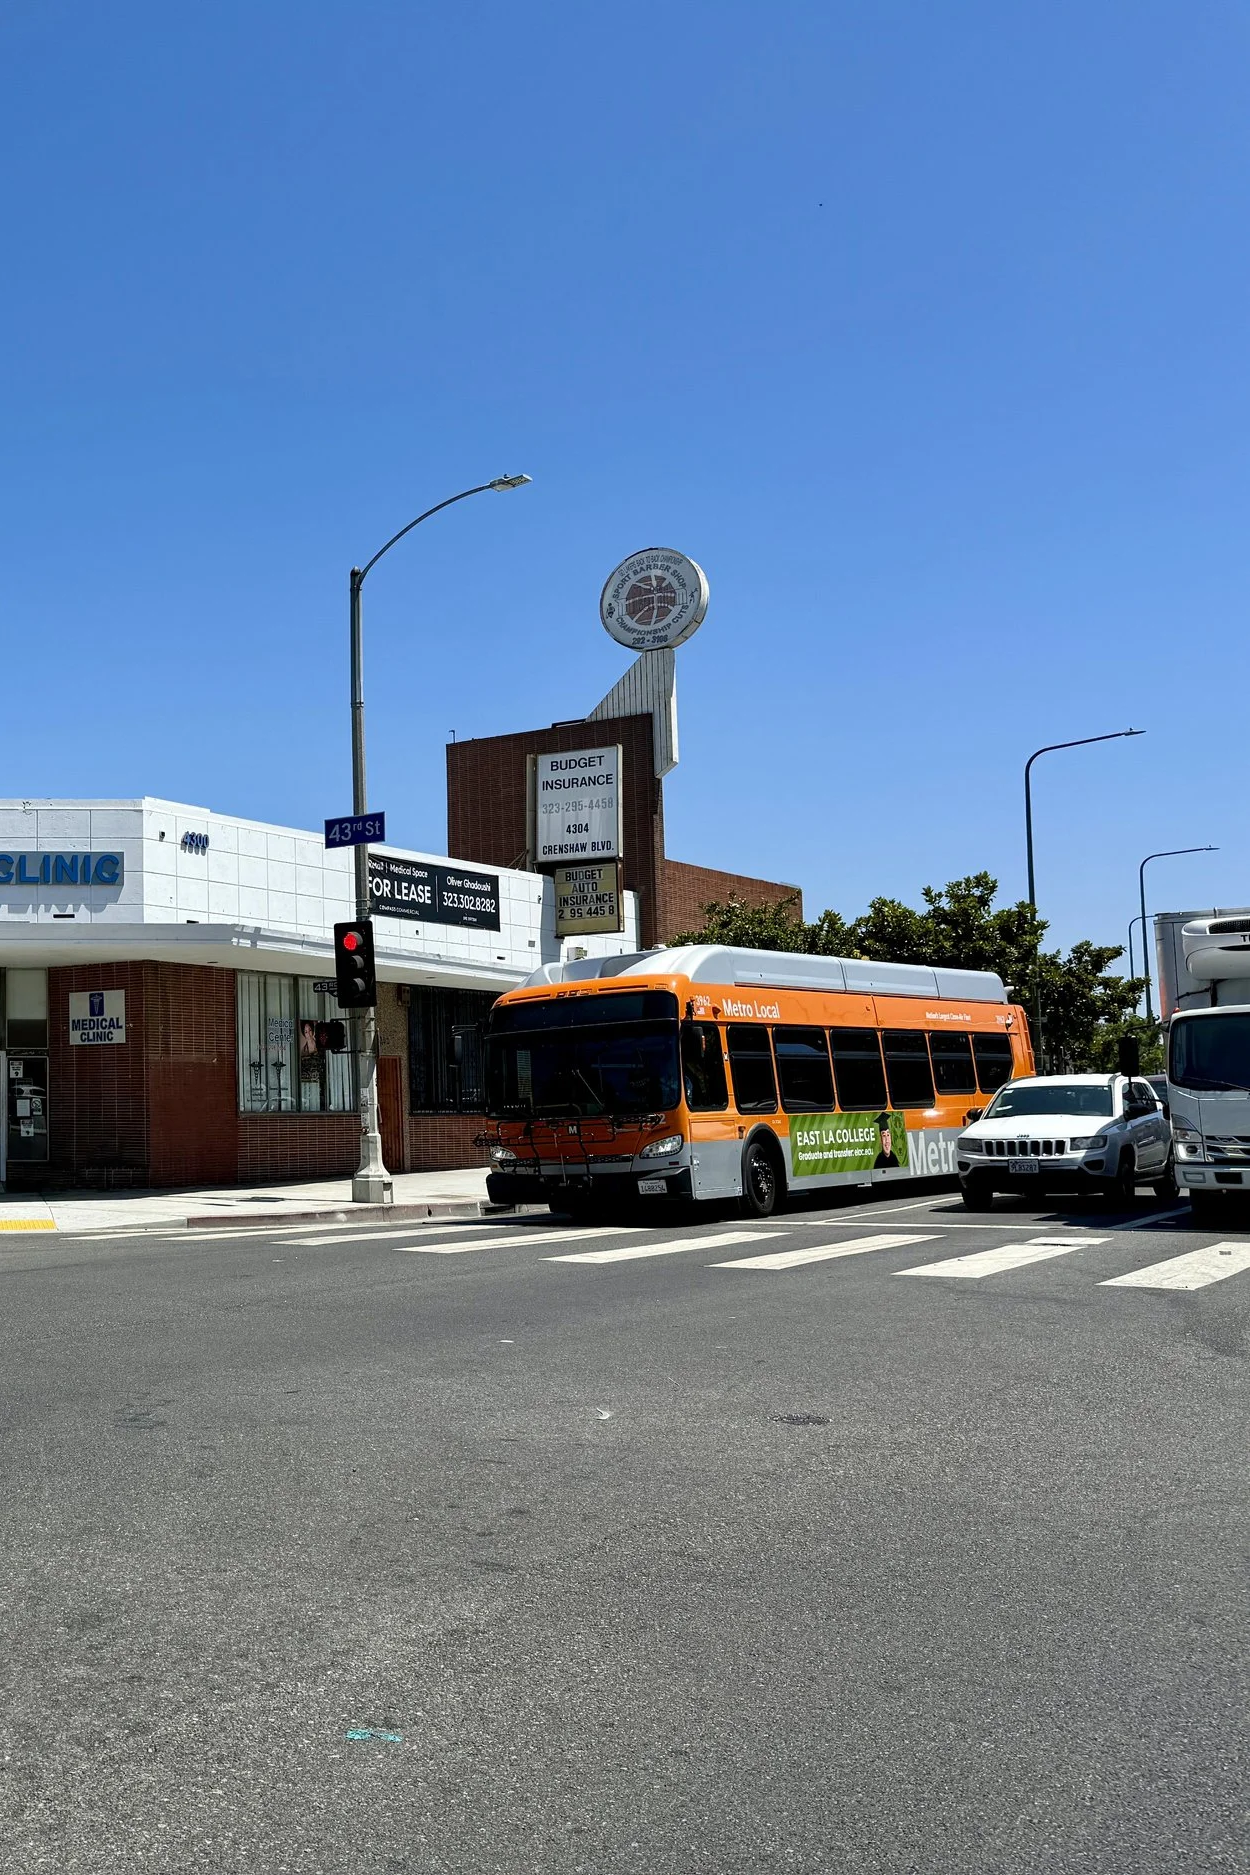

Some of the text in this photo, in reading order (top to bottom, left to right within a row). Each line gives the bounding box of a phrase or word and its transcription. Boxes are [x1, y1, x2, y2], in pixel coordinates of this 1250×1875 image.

[612, 563, 687, 599] SPORT BARBER SHOP
[616, 605, 689, 636] CHAMPIONSHIP CUTS
[550, 755, 605, 772] BUDGET
[542, 773, 614, 791] INSURANCE
[542, 797, 614, 814] 323-295-4458
[366, 820, 381, 836] St
[566, 823, 589, 834] 4304
[181, 831, 209, 848] 4300
[542, 840, 614, 855] CRENSHAW BLVD.
[390, 864, 411, 876] Medical
[412, 867, 428, 878] Space
[565, 869, 603, 881] BUDGET
[446, 876, 491, 892] Oliver Ghadoushi
[572, 882, 598, 893] AUTO
[395, 881, 432, 904] LEASE
[559, 893, 614, 907] INSURANCE
[442, 892, 496, 913] 323.302.8282
[696, 996, 711, 1006] 3962
[722, 999, 781, 1018] Metro Local
[72, 1017, 123, 1032] MEDICAL
[80, 1031, 114, 1043] CLINIC
[796, 1127, 875, 1146] EAST LA COLLEGE
[798, 1149, 823, 1161] Graduate
[823, 1148, 833, 1159] and
[907, 1132, 955, 1176] Metr
